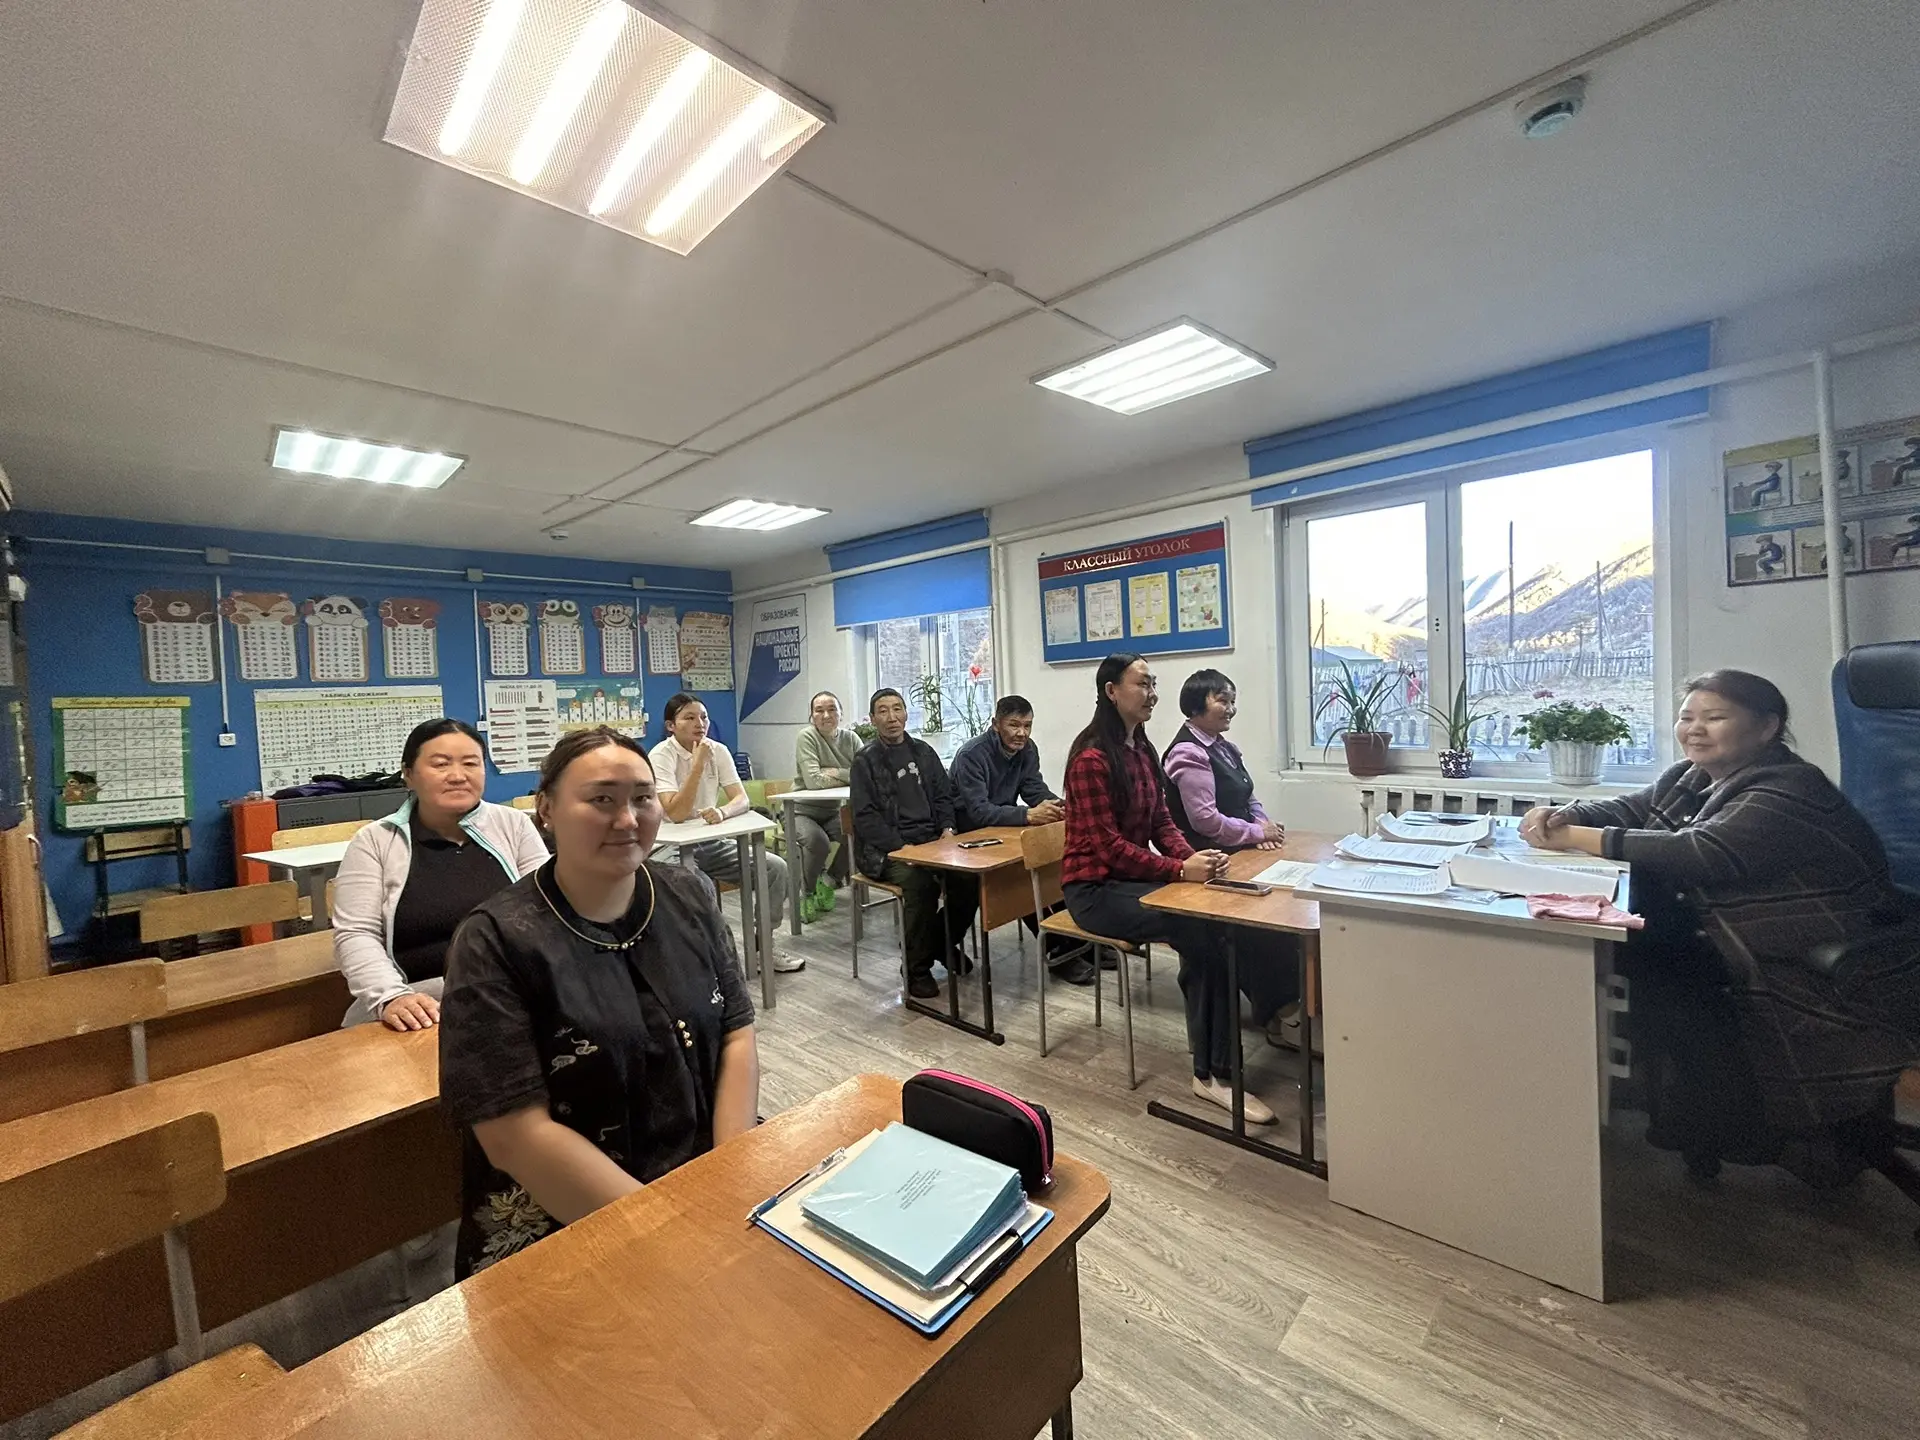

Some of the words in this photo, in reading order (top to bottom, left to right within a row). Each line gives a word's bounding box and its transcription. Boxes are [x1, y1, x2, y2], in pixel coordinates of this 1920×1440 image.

[1063, 547, 1132, 571] КЛАССНЫЙ
[1134, 538, 1191, 558] УГОЛОК
[760, 607, 799, 621] ОБРАЗОВАНИЕ
[755, 628, 799, 647] НАЦИОНАЛЬНЫЕ
[773, 643, 799, 658] ПРОЕКТЫ
[778, 658, 799, 672] РОССИИ
